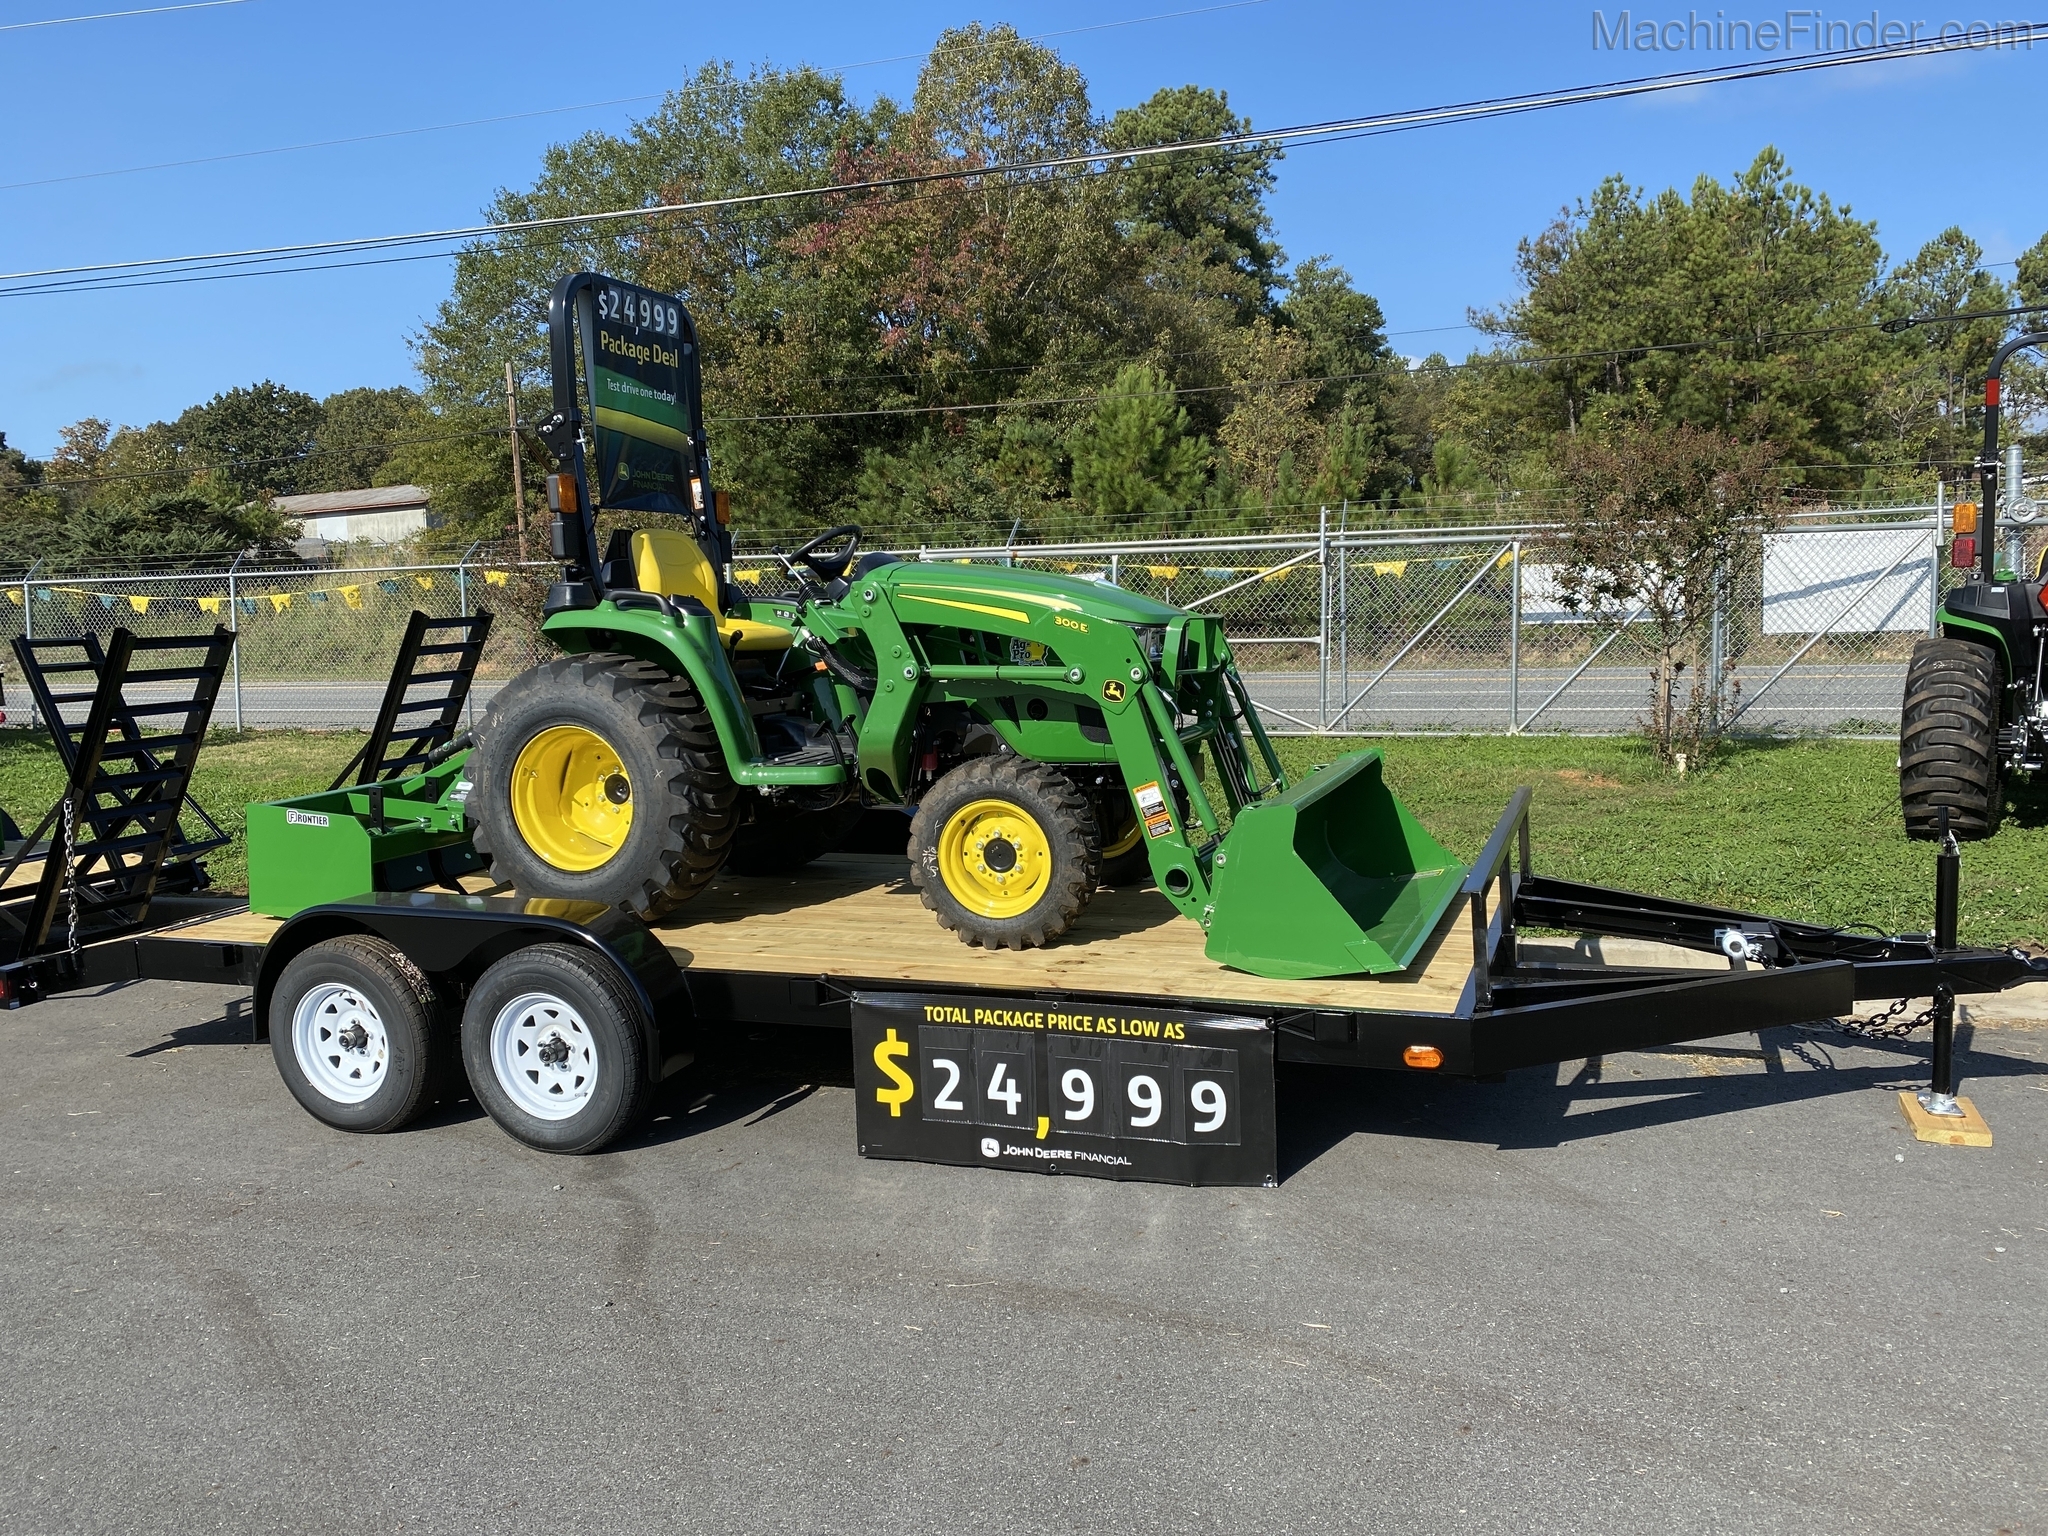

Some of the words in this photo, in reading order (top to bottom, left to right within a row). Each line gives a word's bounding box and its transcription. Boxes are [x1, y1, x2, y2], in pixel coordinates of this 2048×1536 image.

[598, 290, 678, 335] $24,999
[600, 330, 650, 365] Package
[653, 344, 678, 368] Deal
[606, 378, 620, 392] Test
[621, 381, 639, 396] drive
[640, 388, 653, 398] one
[653, 389, 677, 406] today!
[632, 468, 650, 479] JOHN
[651, 470, 675, 482] DEERE
[1012, 649, 1031, 660] Pro
[287, 810, 328, 826] FRONTIER
[924, 1006, 971, 1025] TOTAL
[974, 1009, 1044, 1029] PACKAGE
[1047, 1013, 1093, 1033] PRICE
[1096, 1017, 1117, 1035] AS
[1121, 1018, 1160, 1038] LOW
[1163, 1022, 1185, 1041] AS
[873, 1028, 1228, 1140] $24,999
[1002, 1144, 1034, 1158] JOHN
[1035, 1147, 1072, 1160] DEERE
[1074, 1151, 1132, 1166] FINANCIAL
